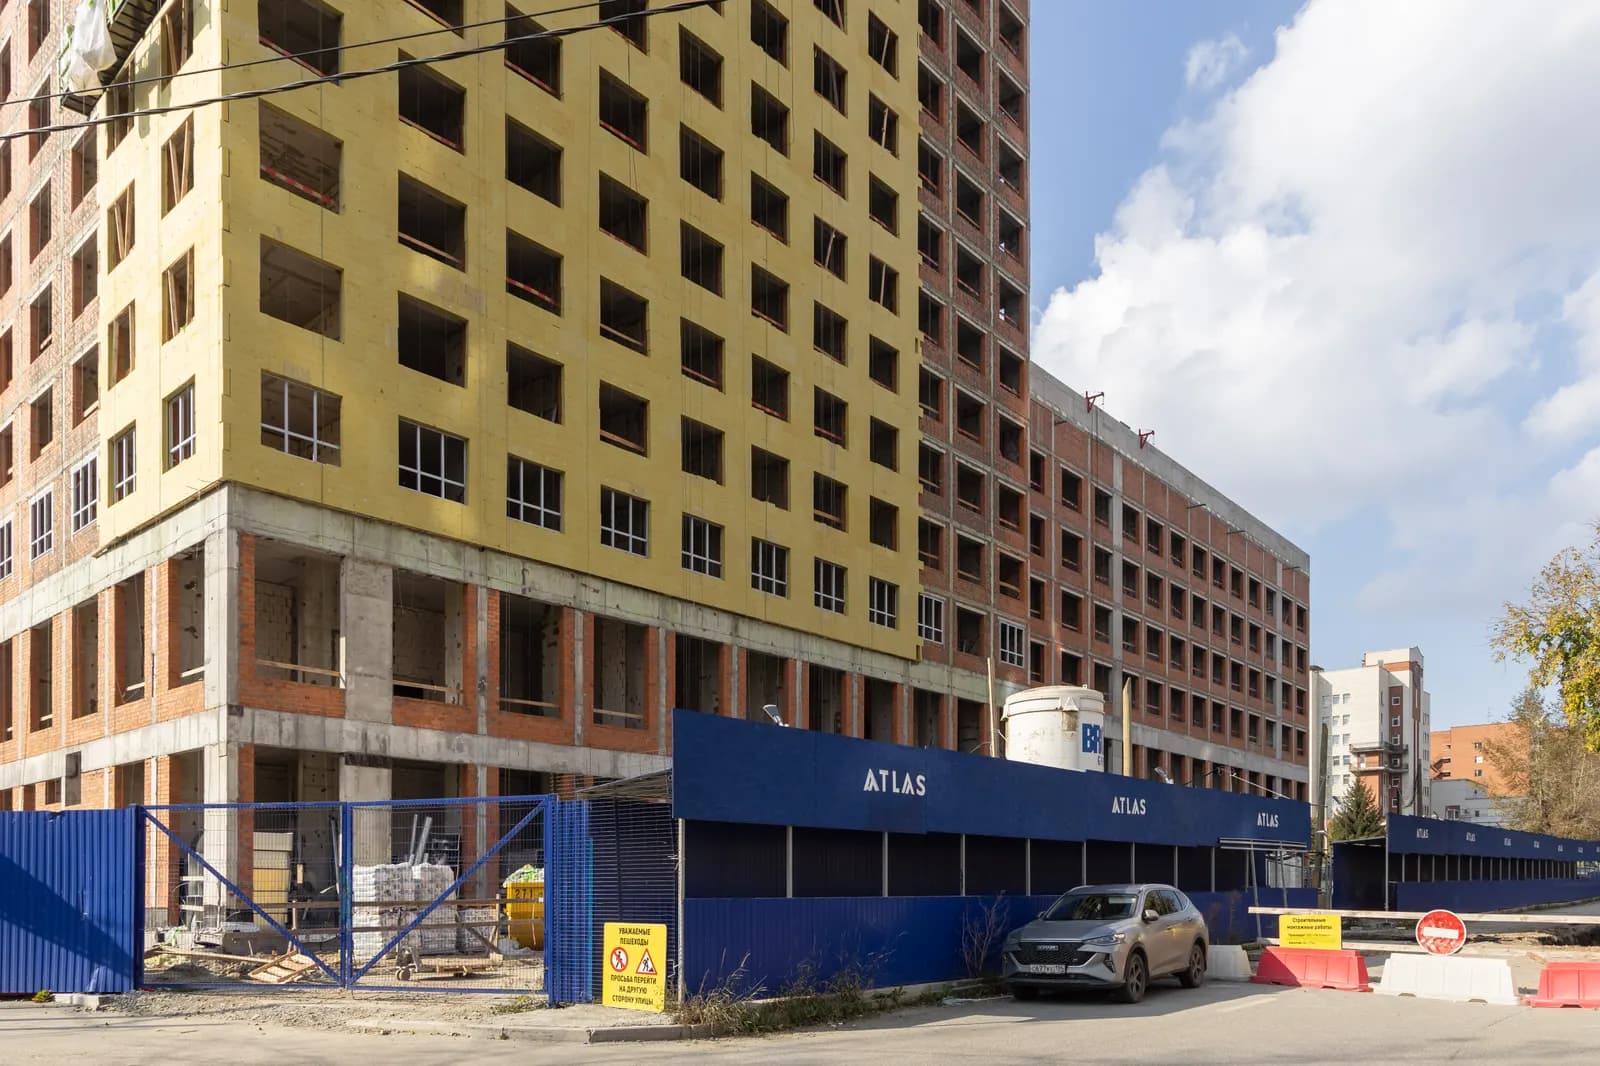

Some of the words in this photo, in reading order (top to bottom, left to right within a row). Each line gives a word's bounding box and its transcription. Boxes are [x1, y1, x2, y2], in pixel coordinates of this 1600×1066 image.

[863, 768, 926, 796] ATLAS
[1111, 796, 1146, 815] ATLAS
[1257, 809, 1279, 828] ATLAS
[618, 927, 651, 936] УВАЖАЕМЫЕ
[620, 937, 649, 946] ПЕШЕХОДЫ
[610, 974, 633, 983] ПРОСЬБА
[634, 976, 657, 984] ПЕРЕЙТИ
[618, 985, 626, 993] НА
[626, 986, 648, 994] ДРУГУЮ
[612, 995, 634, 1003] СТОРОНУ
[635, 997, 654, 1005] УЛИЦЫ
